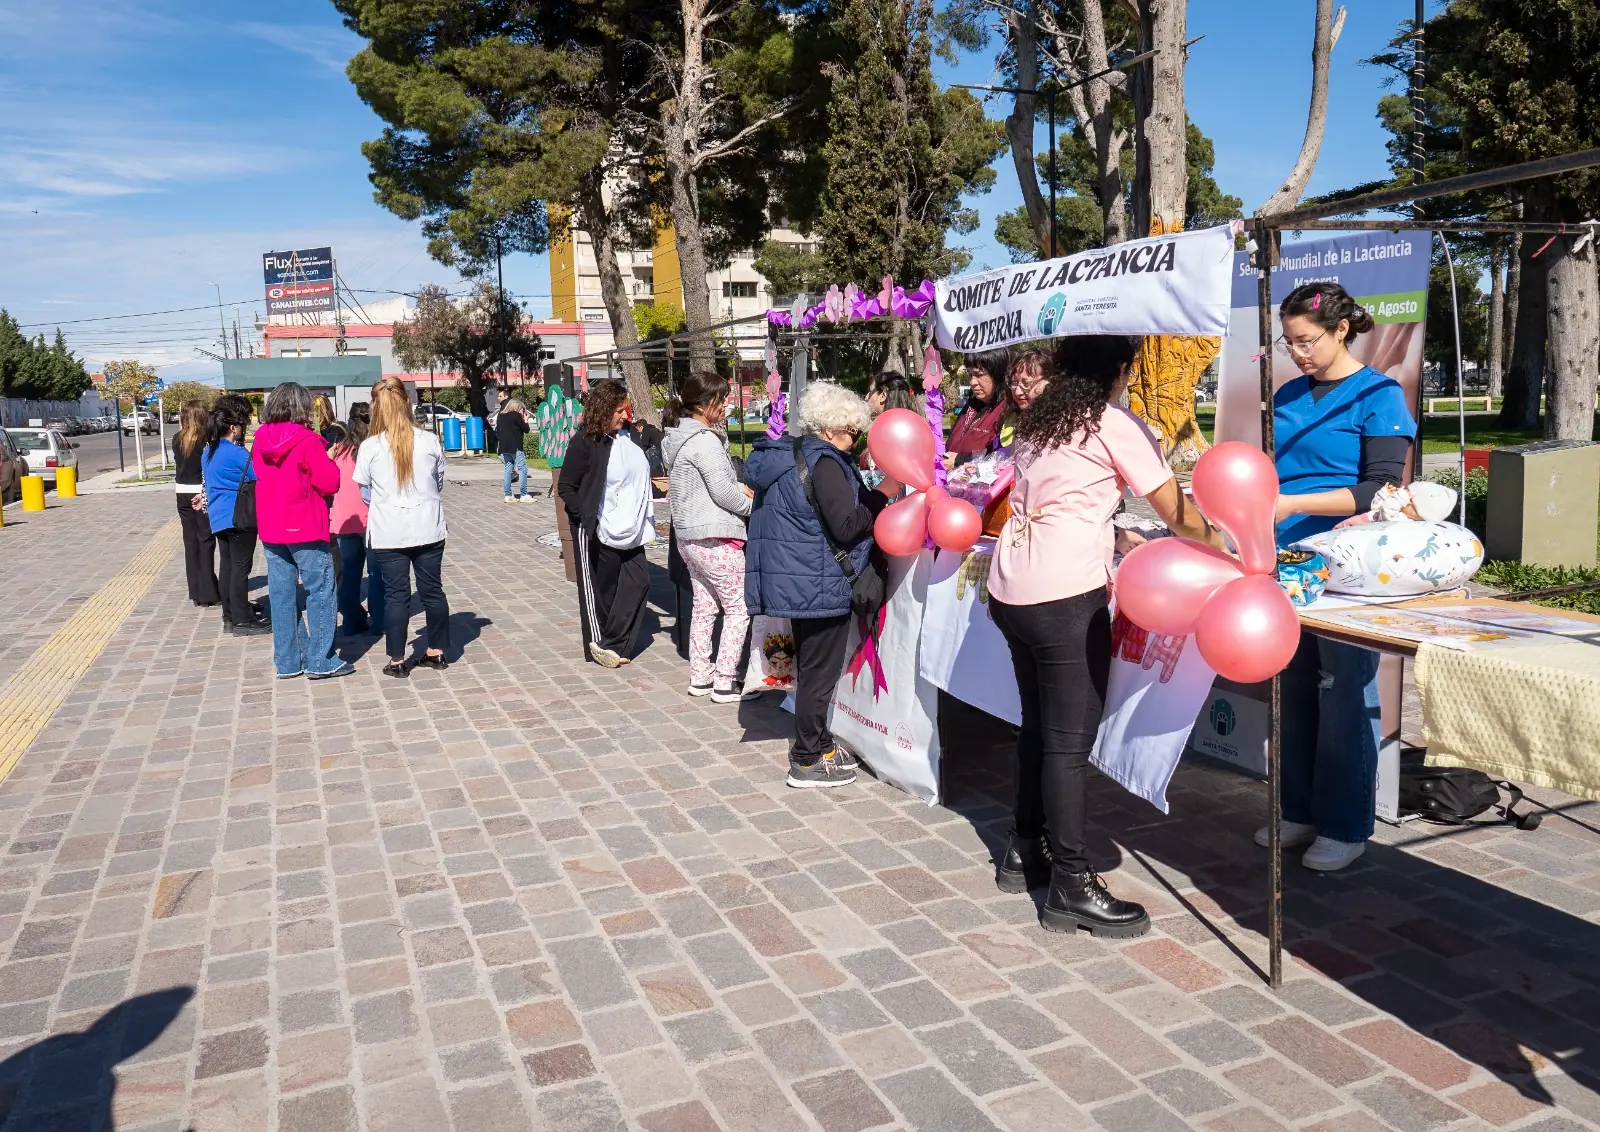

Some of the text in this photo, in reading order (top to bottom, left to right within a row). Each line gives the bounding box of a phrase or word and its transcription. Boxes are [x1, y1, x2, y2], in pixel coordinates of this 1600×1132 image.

[265, 257, 292, 270] Flux
[1239, 239, 1412, 277] Sema Mundial de la Lactancia
[943, 242, 1176, 313] COMITE DE LACTANCIA
[1362, 299, 1418, 318] de Agosto
[953, 310, 1023, 349] MATERNA
